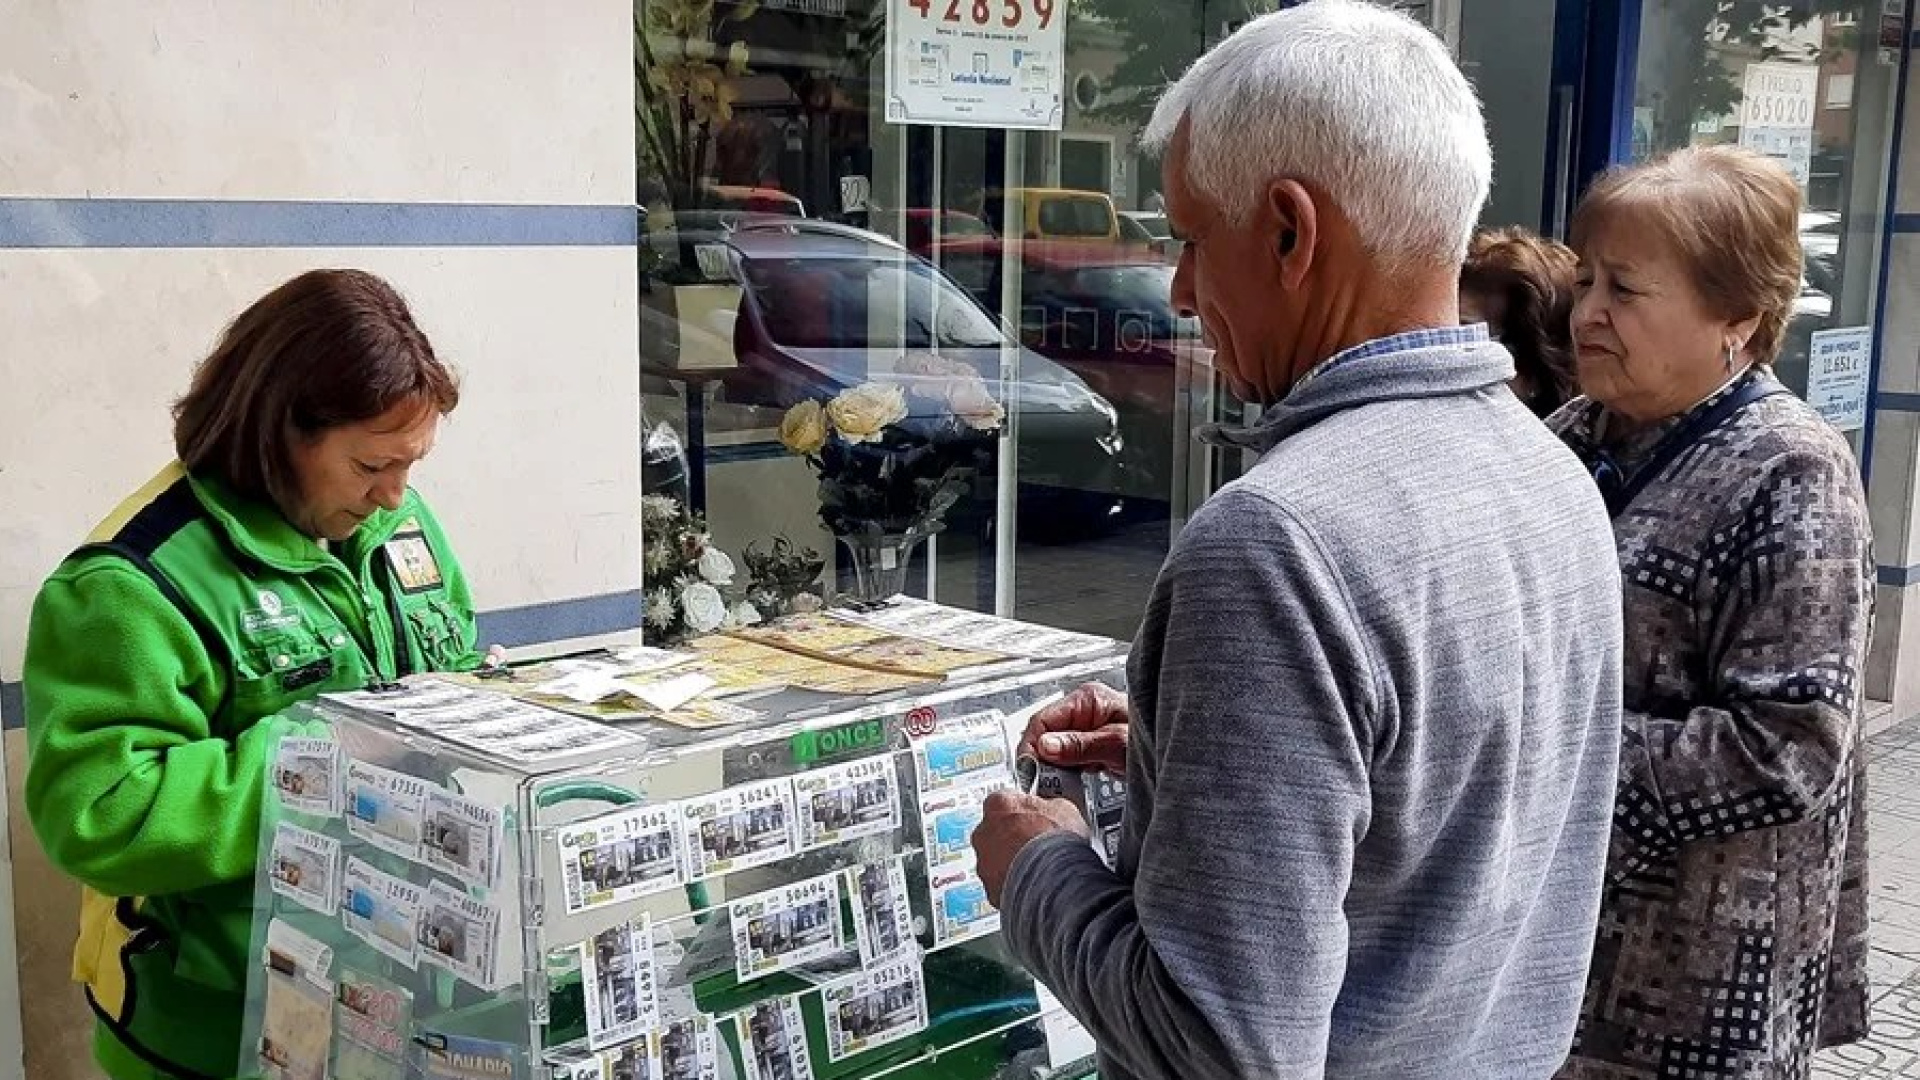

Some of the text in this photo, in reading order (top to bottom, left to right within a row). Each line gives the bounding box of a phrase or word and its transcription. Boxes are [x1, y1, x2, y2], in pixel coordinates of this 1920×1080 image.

[907, 0, 1054, 30] 42859
[1751, 96, 1808, 124] 65020
[820, 720, 881, 751] ONCE
